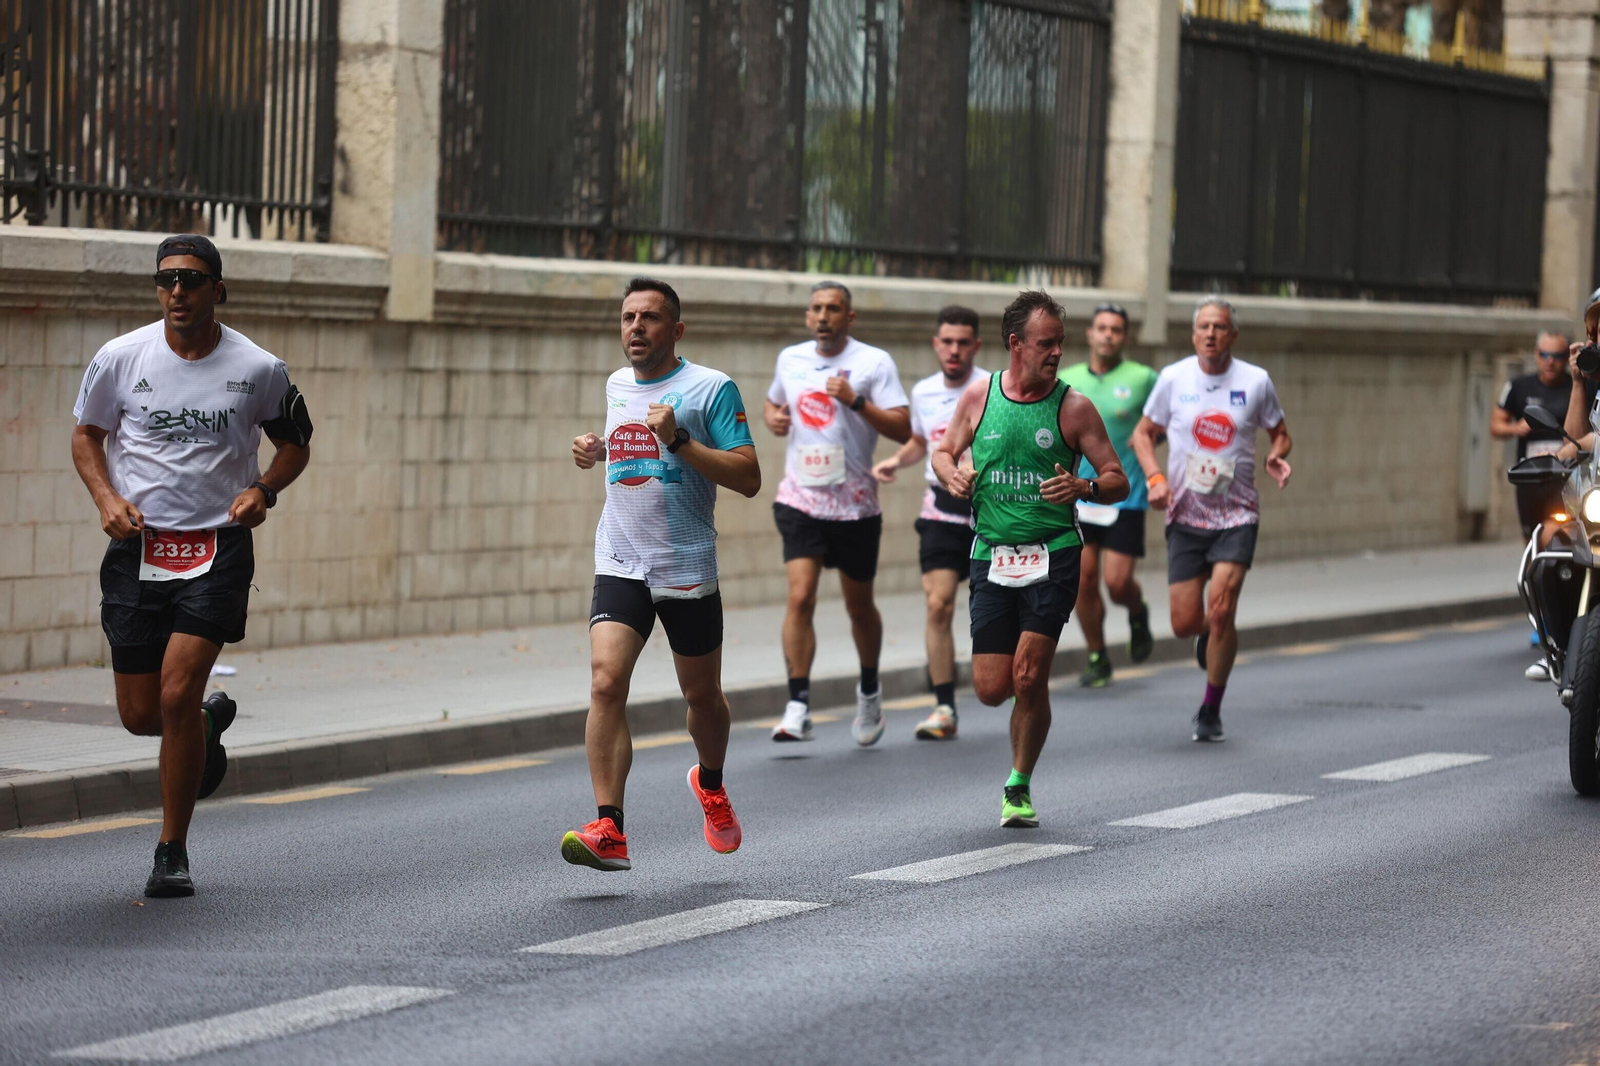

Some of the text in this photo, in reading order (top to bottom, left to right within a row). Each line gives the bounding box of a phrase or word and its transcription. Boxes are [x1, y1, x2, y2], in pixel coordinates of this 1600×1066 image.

[614, 431, 650, 441] Café Bar
[609, 442, 656, 452] Los Rombos
[638, 465, 643, 475] y
[644, 461, 664, 475] Tapas
[991, 465, 1045, 490] mijas
[153, 543, 207, 558] 2323
[997, 553, 1040, 567] 1172
